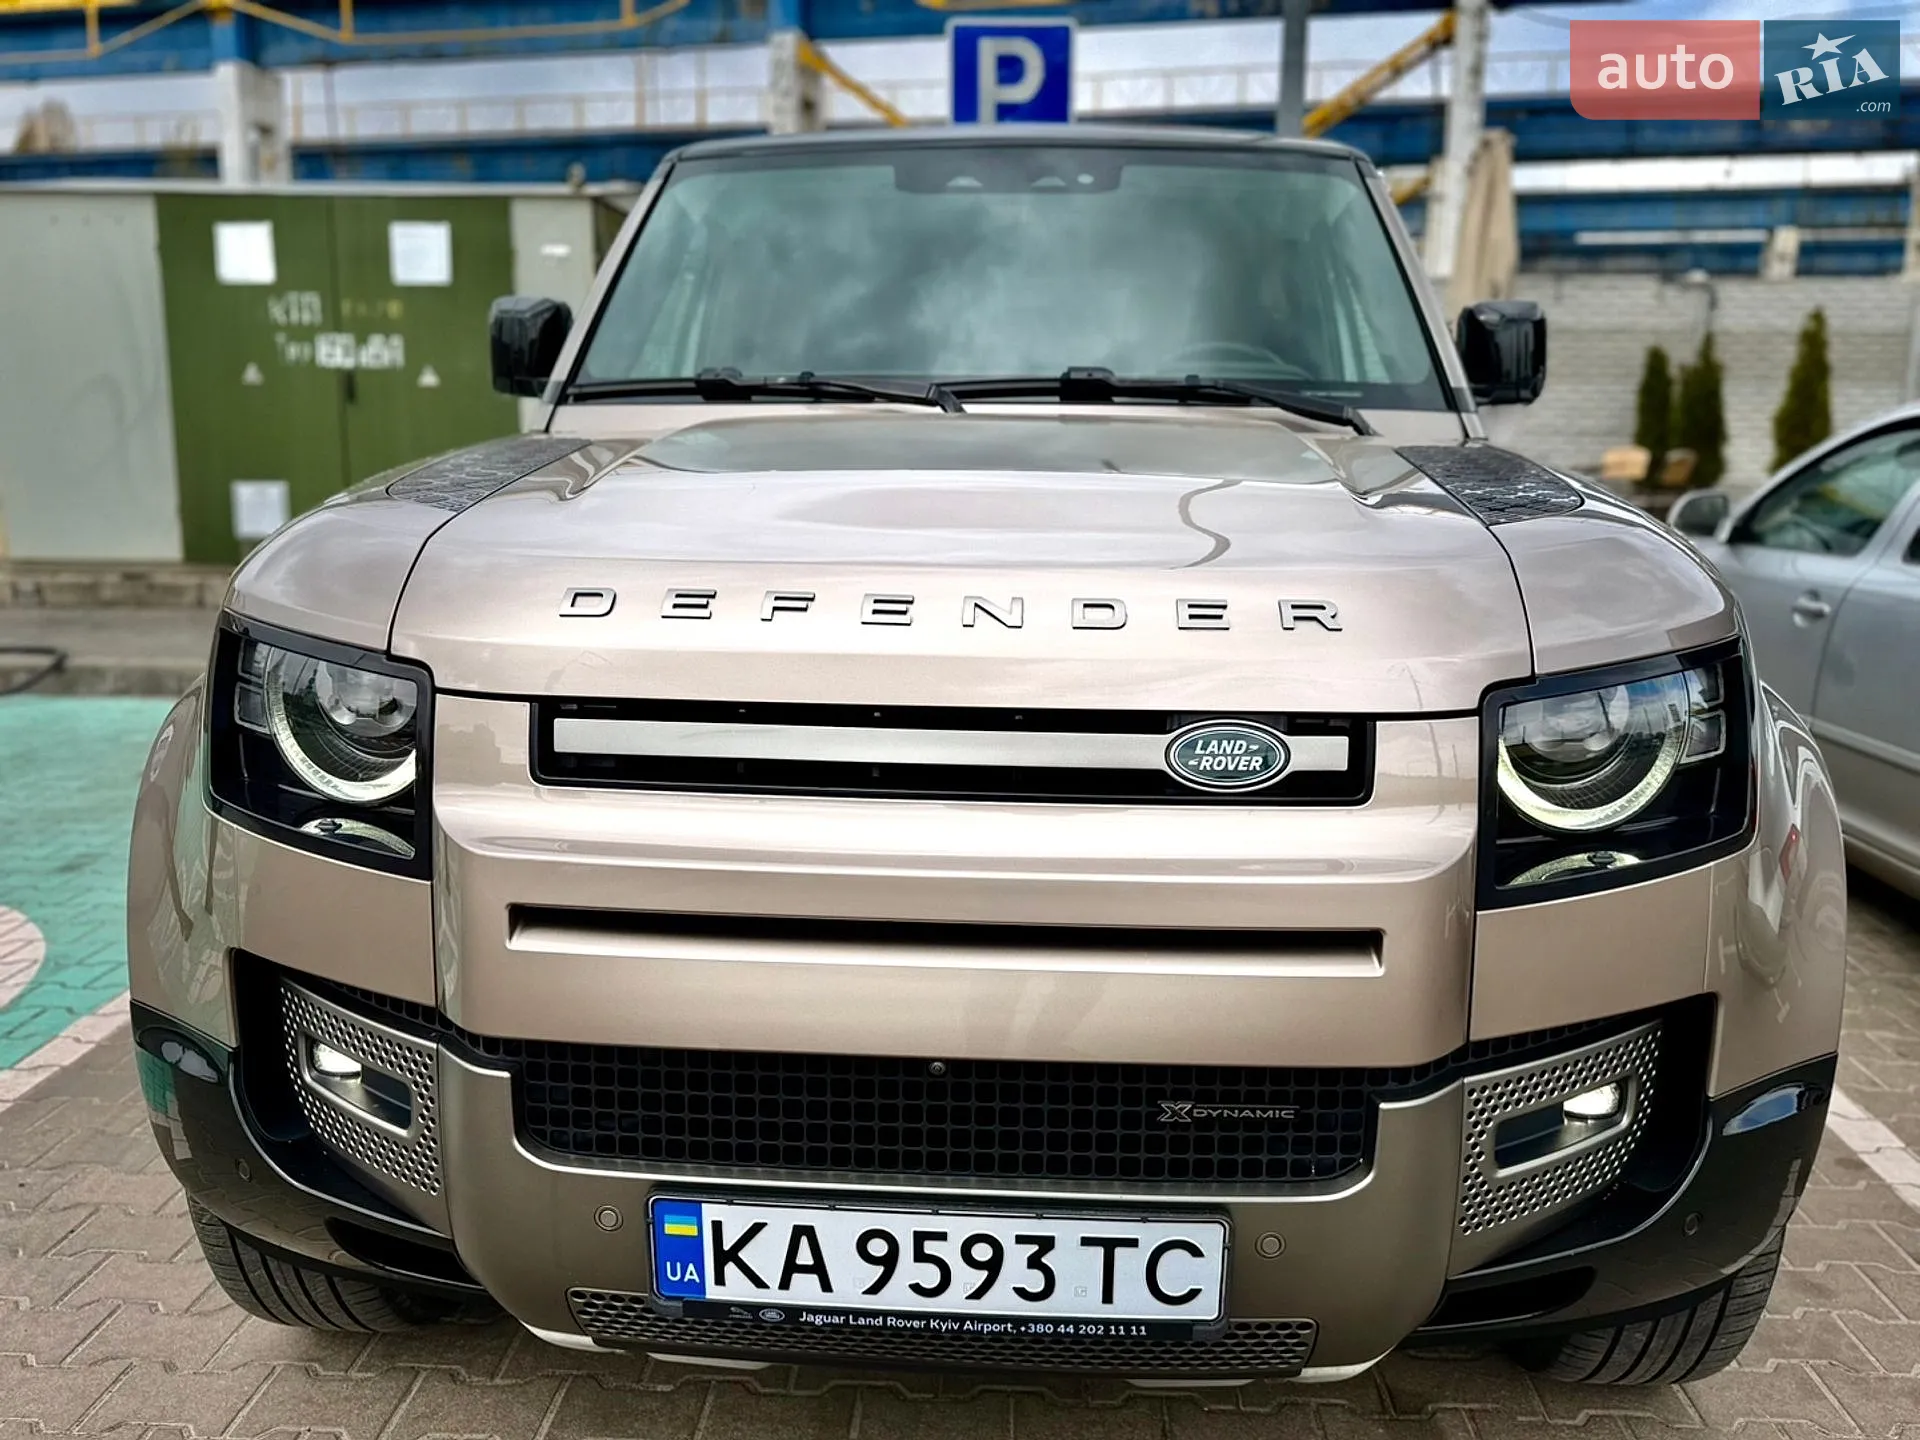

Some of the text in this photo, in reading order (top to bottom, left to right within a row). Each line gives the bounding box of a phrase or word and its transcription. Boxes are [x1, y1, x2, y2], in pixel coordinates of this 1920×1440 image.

[976, 36, 1046, 124] P
[558, 586, 1343, 631] DEFENDER
[666, 1261, 700, 1283] UA
[710, 1219, 1206, 1306] KA 9593 TC
[799, 1311, 1148, 1336] Jaguar Land Rover Kyiv Airport, +380 44 202 11 11
